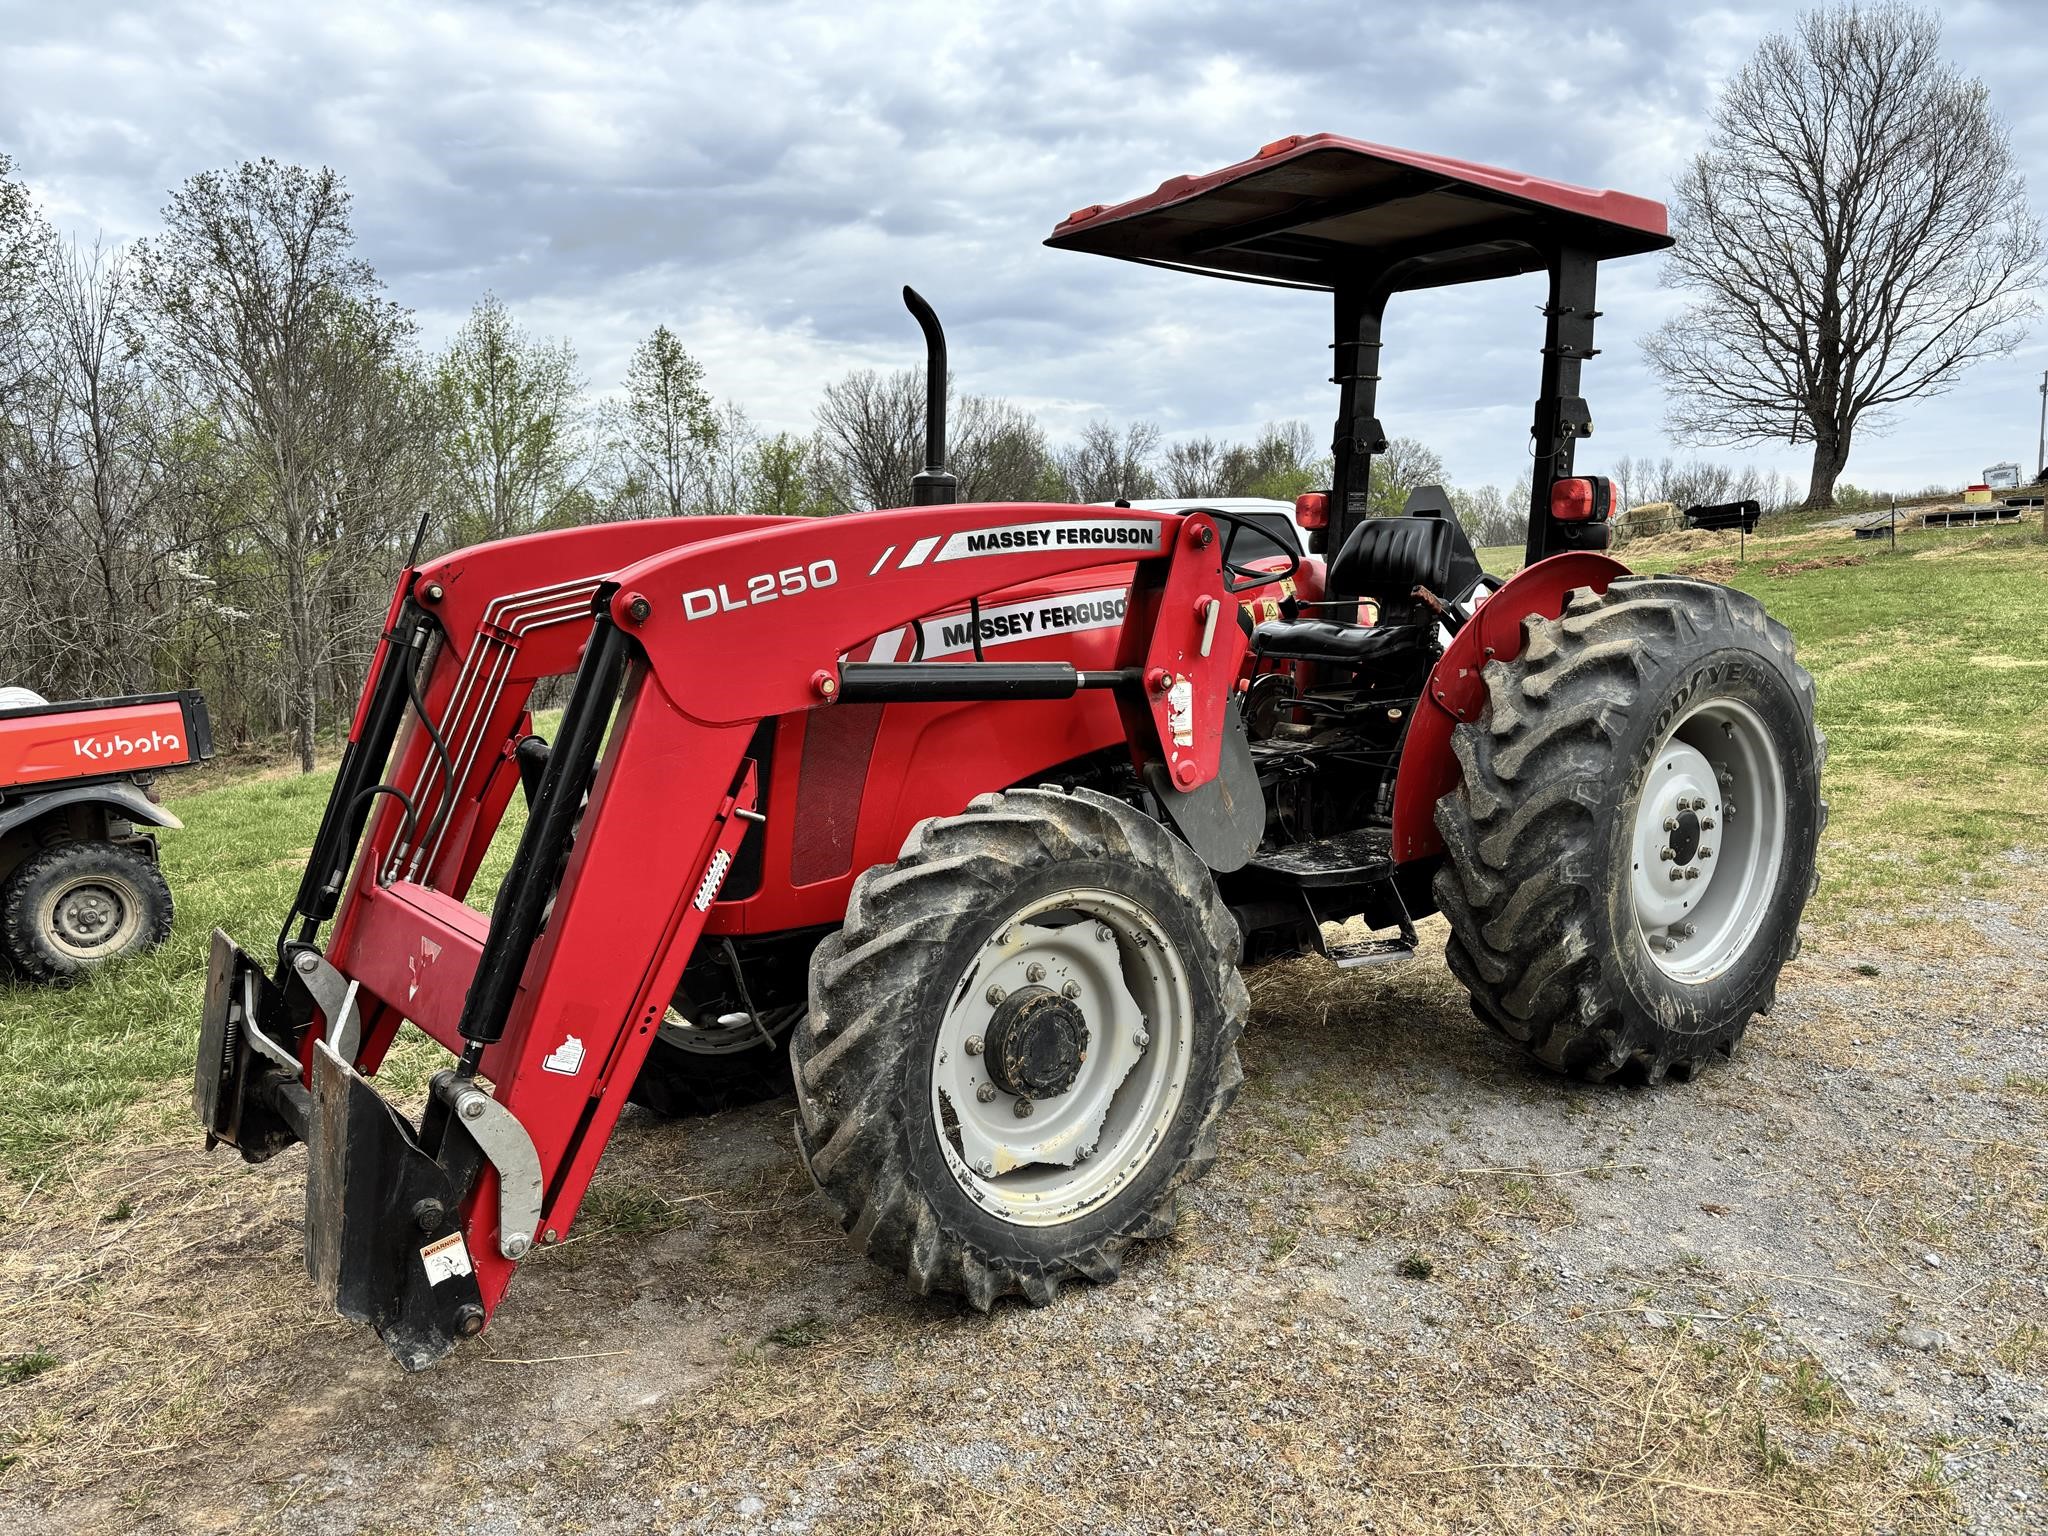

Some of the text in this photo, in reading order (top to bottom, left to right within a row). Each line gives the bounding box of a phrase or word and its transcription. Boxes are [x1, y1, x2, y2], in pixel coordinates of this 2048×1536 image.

[967, 527, 1153, 552] MASSEY FERGUSON
[682, 558, 838, 621] DL250
[942, 600, 1127, 648] MASSEY FERGUSO
[73, 730, 180, 760] Kubota
[430, 1235, 461, 1254] WARNING
